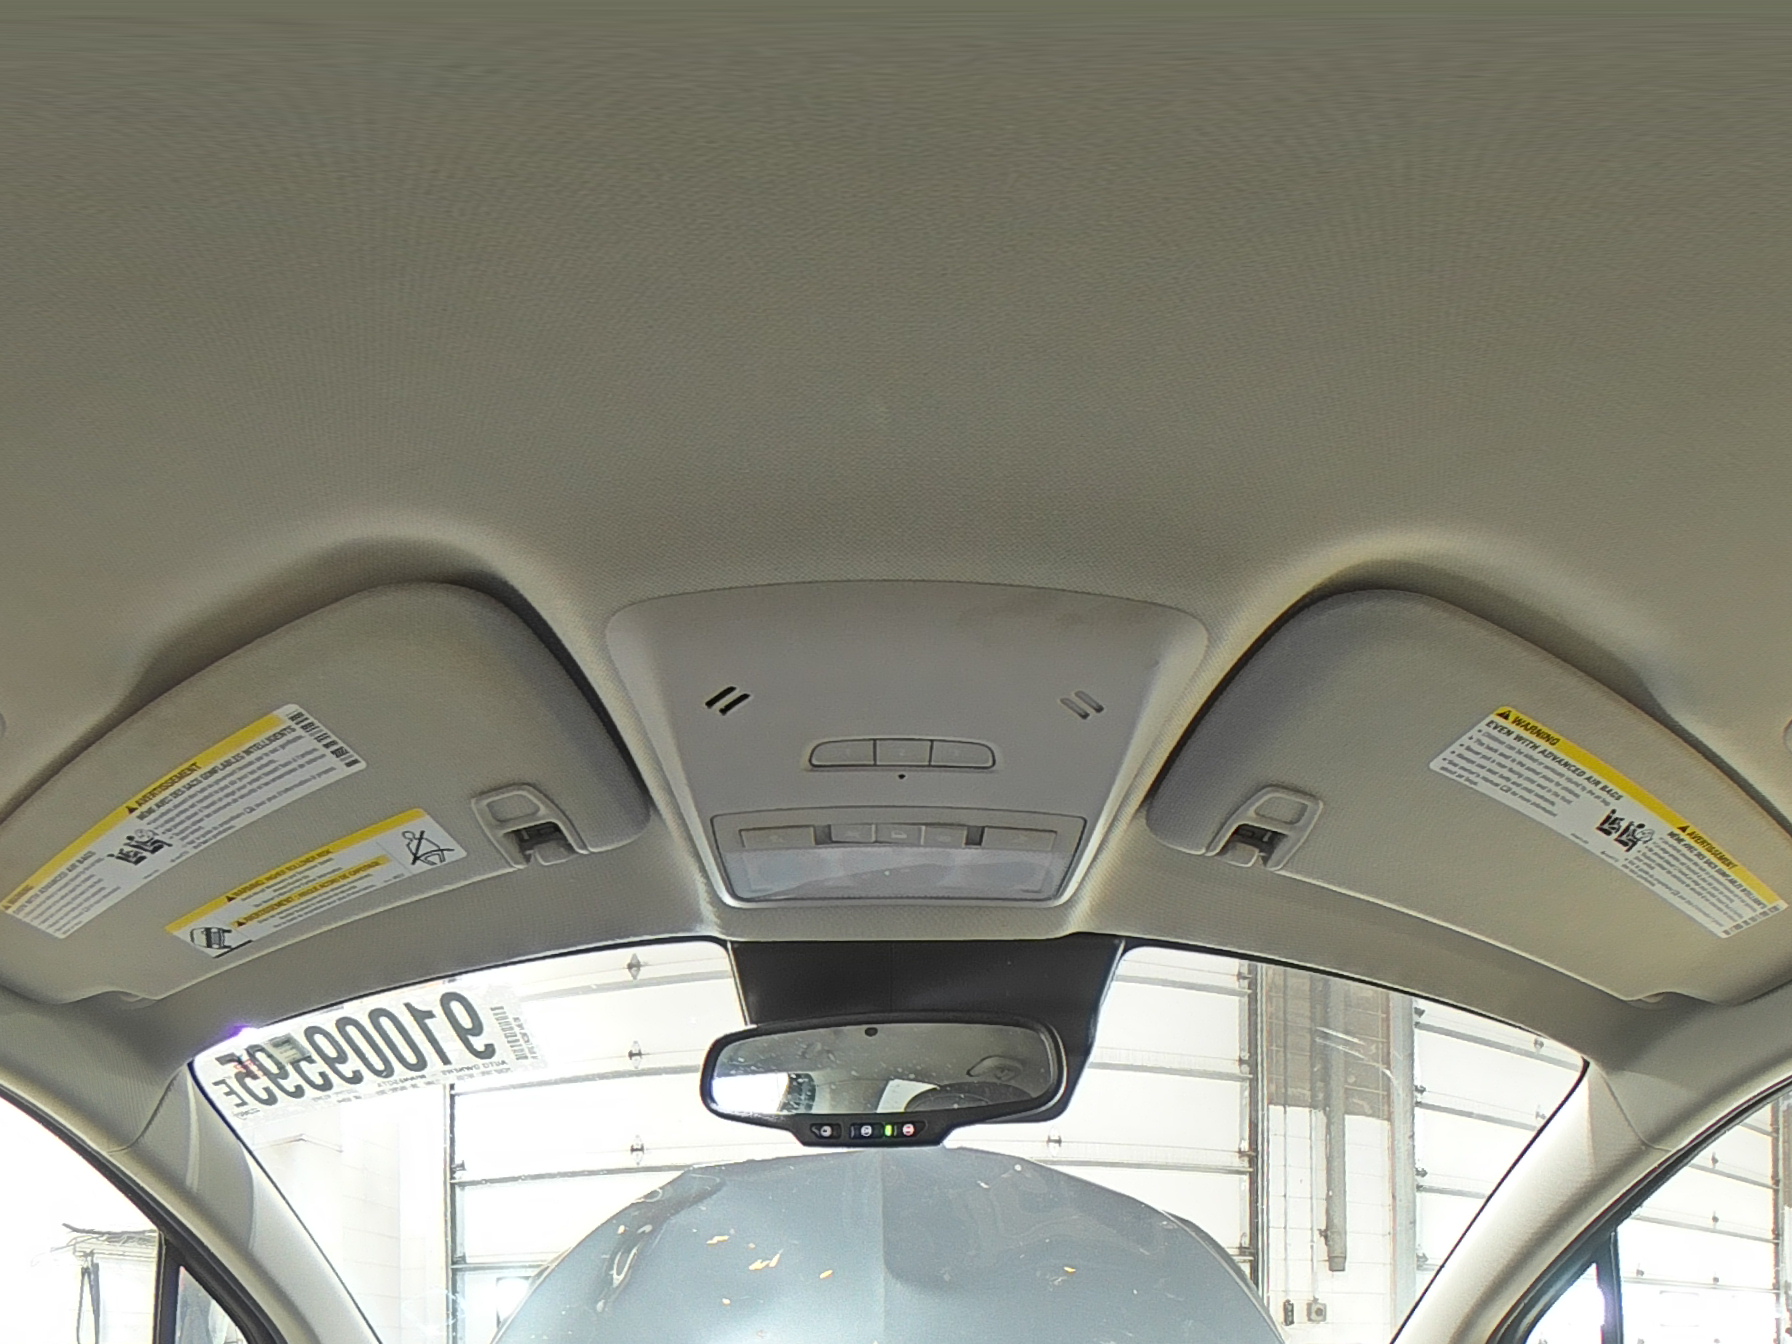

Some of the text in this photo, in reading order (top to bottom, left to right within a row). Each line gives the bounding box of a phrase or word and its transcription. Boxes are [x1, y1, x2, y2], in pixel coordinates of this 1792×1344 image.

[1510, 716, 1560, 747] WARNING
[1485, 719, 1514, 737] EVEN
[1513, 733, 1540, 751] WITH
[1538, 747, 1586, 777] ADVANCED
[1584, 774, 1601, 786] AIR
[1598, 784, 1623, 801] BAGS
